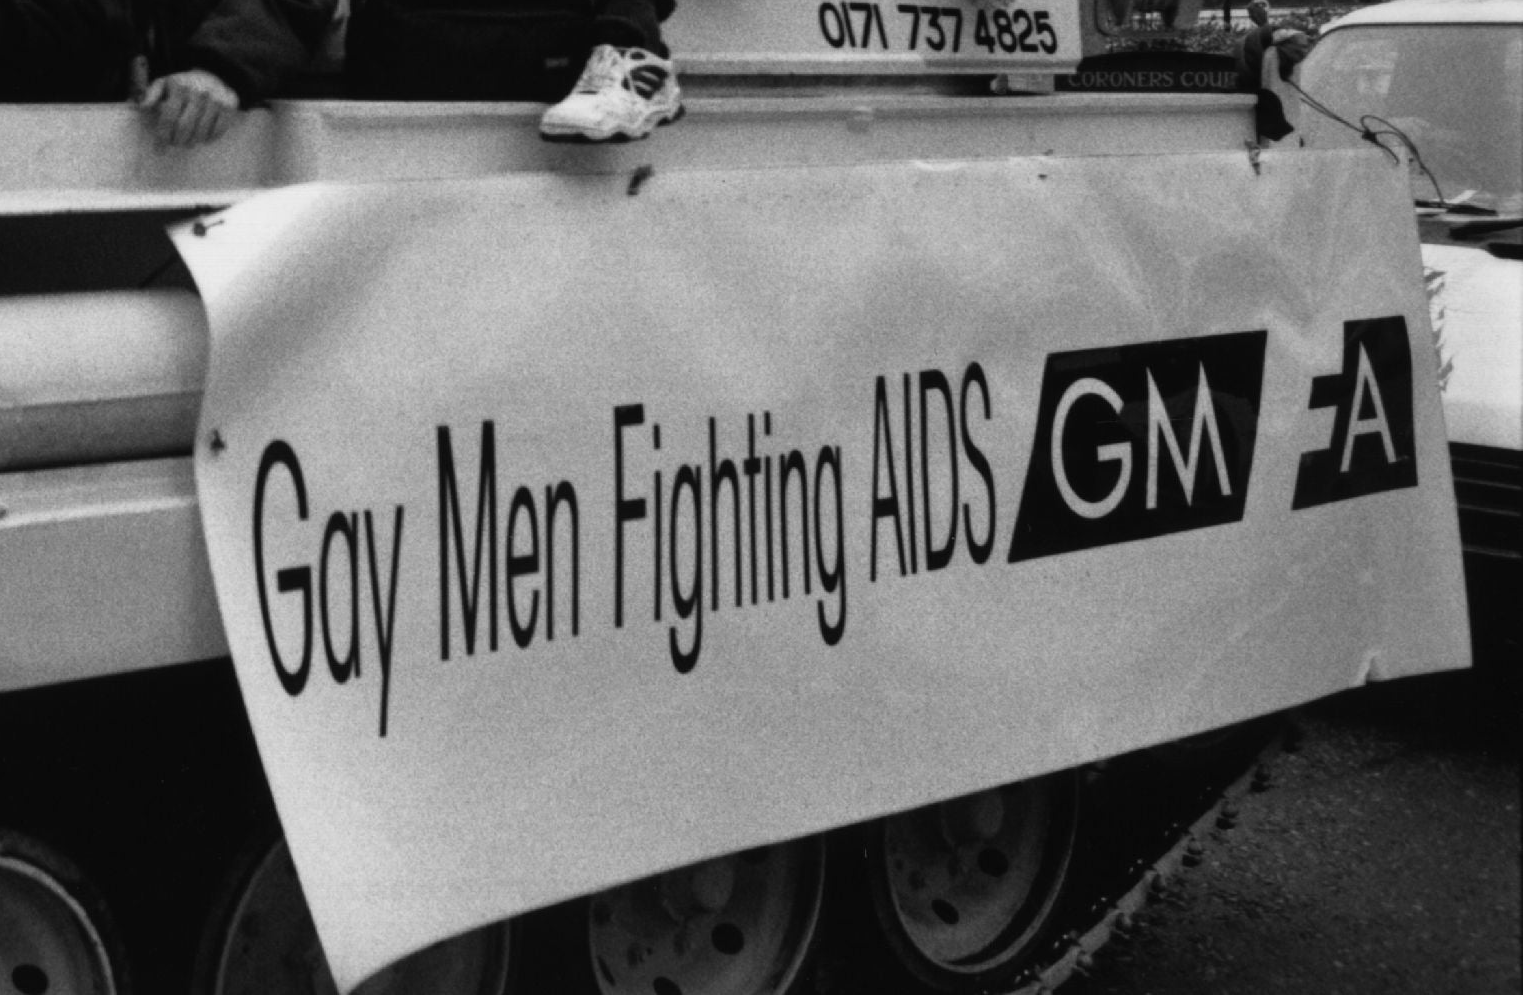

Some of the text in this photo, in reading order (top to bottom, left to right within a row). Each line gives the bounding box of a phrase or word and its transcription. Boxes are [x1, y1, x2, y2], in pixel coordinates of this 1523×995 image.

[818, 1, 1058, 55] 0171 737 4825
[1069, 70, 1174, 87] CORONERS
[253, 361, 997, 738] Gay Men Fighting AIDS
